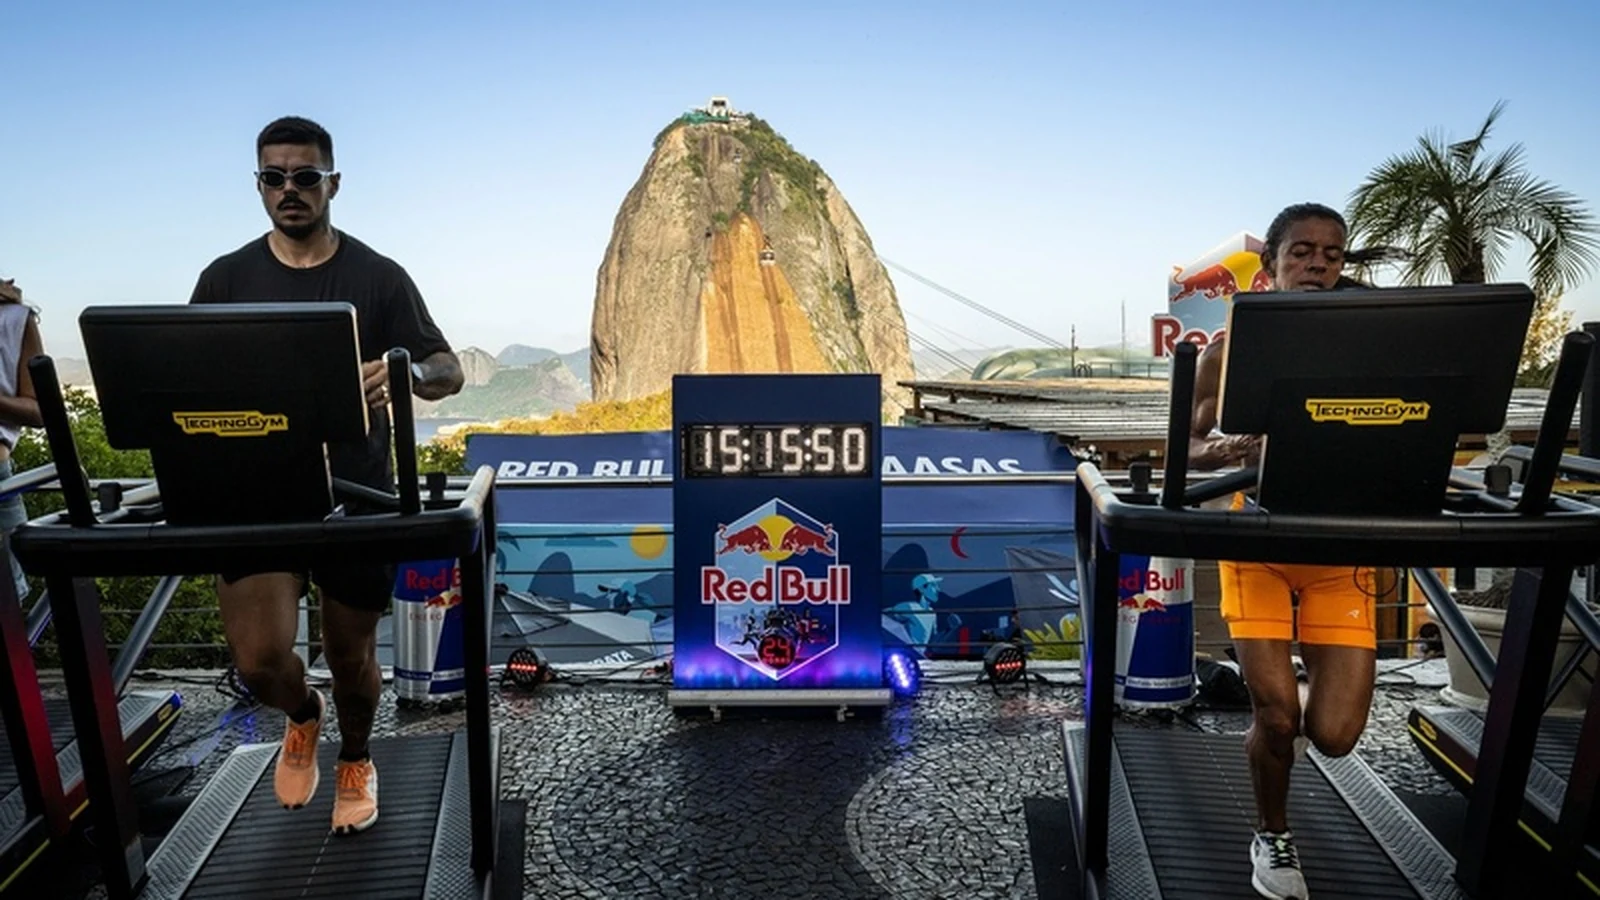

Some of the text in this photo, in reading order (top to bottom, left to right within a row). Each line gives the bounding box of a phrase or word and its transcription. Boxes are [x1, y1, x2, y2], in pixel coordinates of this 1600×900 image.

[704, 427, 866, 473] 15:15:50
[405, 568, 448, 590] Red
[702, 566, 850, 604] Red Bull
[1146, 567, 1185, 591] Bull
